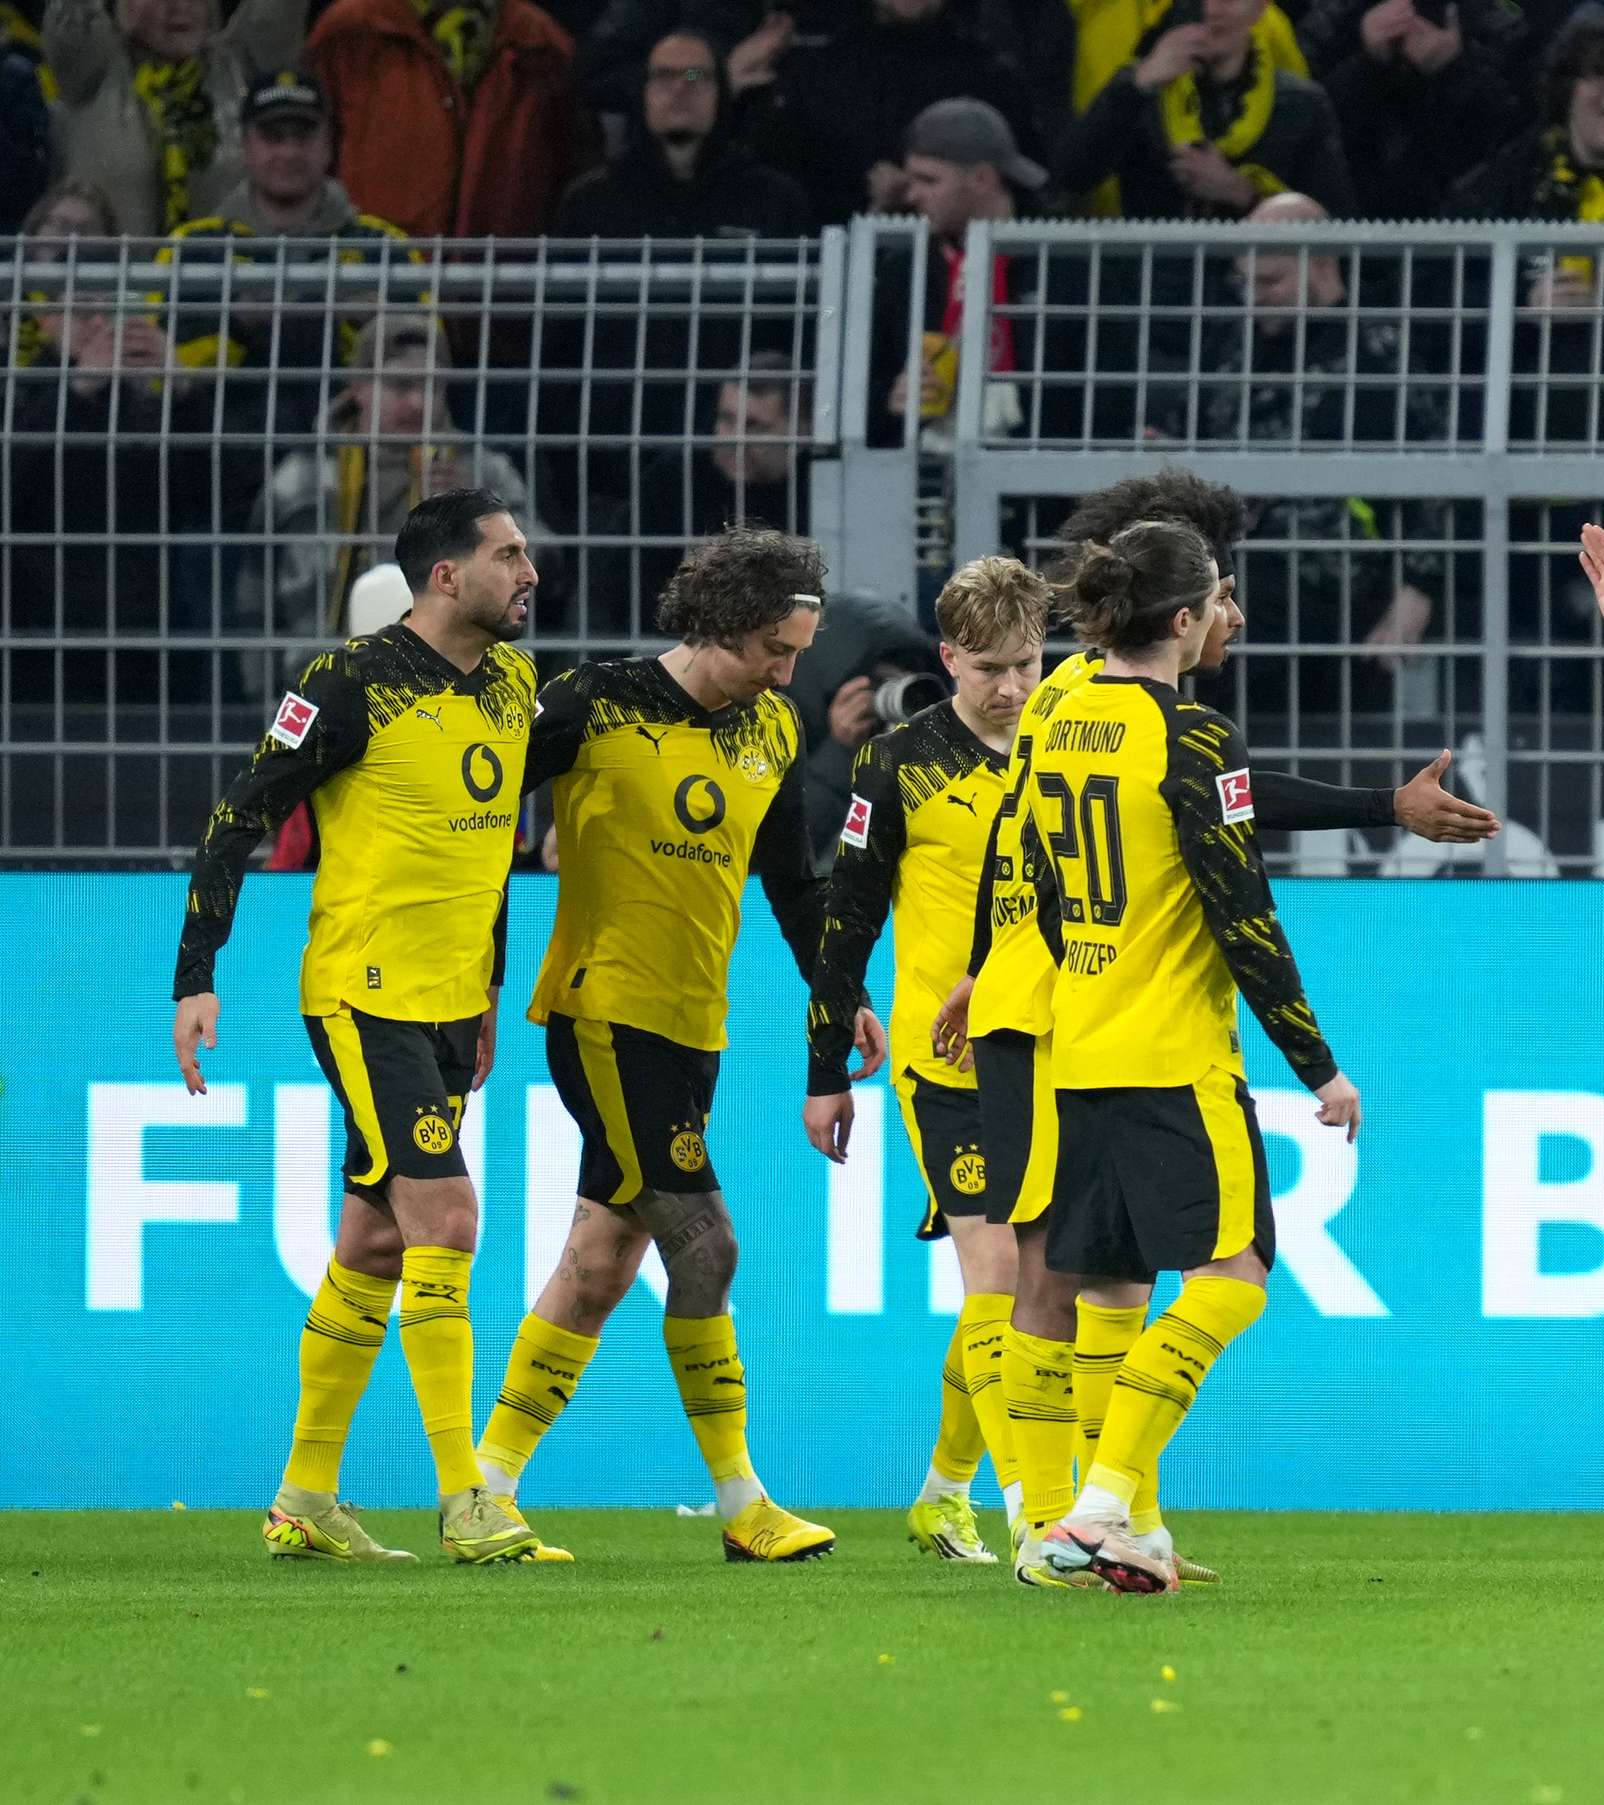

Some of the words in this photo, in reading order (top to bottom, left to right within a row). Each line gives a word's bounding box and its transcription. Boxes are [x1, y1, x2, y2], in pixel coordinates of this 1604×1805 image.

[506, 705, 525, 729] BVB
[447, 810, 513, 833] vodafone
[650, 839, 732, 868] vodafone
[1035, 771, 1128, 927] 20
[418, 1118, 448, 1144] BVB
[431, 1139, 443, 1150] 09
[955, 1158, 986, 1185] BVB
[966, 1180, 980, 1191] 09
[684, 1357, 730, 1372] BVB
[1160, 1342, 1206, 1371] BVB
[530, 1359, 577, 1381] BVB
